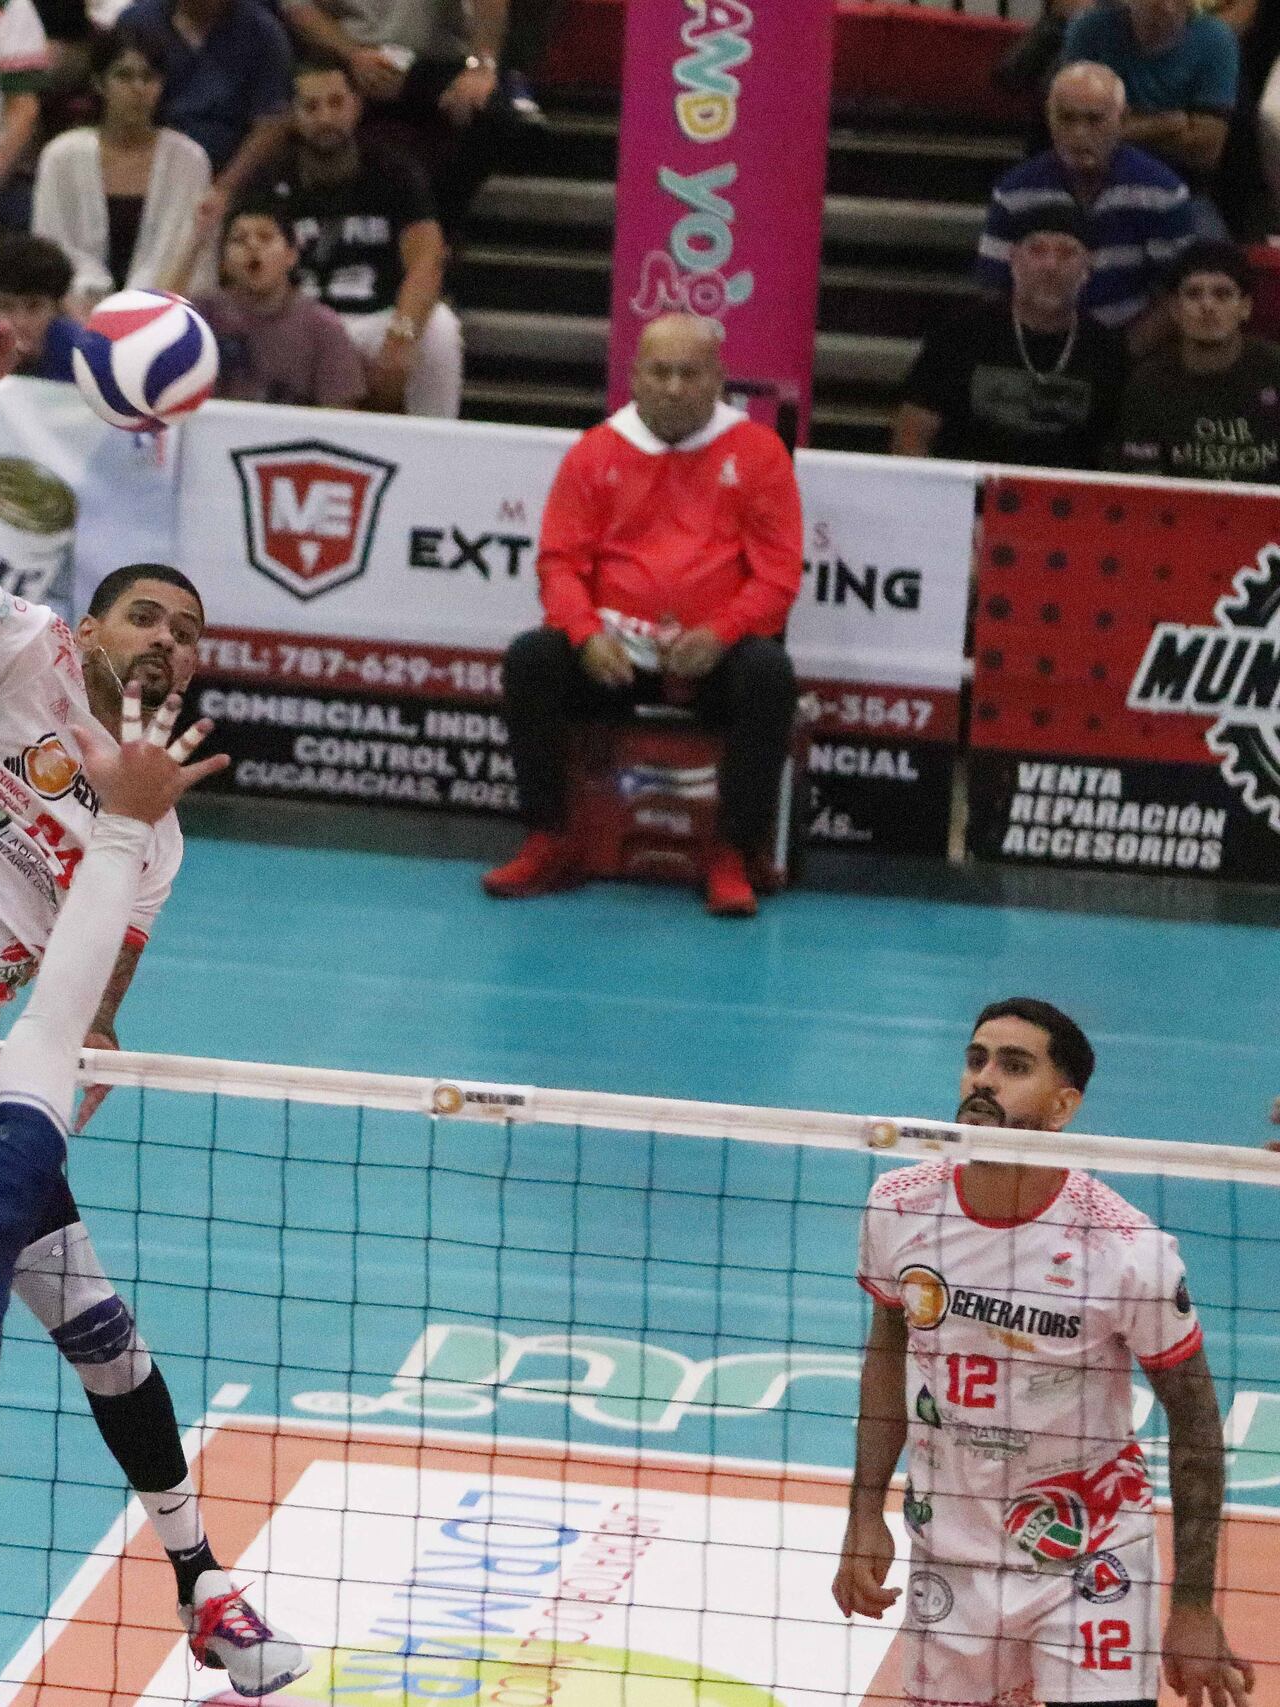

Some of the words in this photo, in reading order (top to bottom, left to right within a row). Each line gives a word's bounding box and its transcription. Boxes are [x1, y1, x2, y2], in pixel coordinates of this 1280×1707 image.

[1195, 417, 1253, 443] OUR
[270, 476, 354, 538] ME
[803, 555, 923, 613] ING
[199, 638, 268, 671] TEL:
[1128, 623, 1280, 716] MUN
[296, 735, 457, 777] CONTROL
[461, 751, 484, 779] Y
[1017, 761, 1122, 799] VENTA
[1008, 793, 1228, 837] REPARACIÓN
[1001, 825, 1223, 872] ACCESORIOS
[950, 1289, 1081, 1339] GENERATORS
[945, 1351, 999, 1409] 12
[329, 1488, 603, 1700] LORIMAR
[1079, 1619, 1132, 1671] 12
